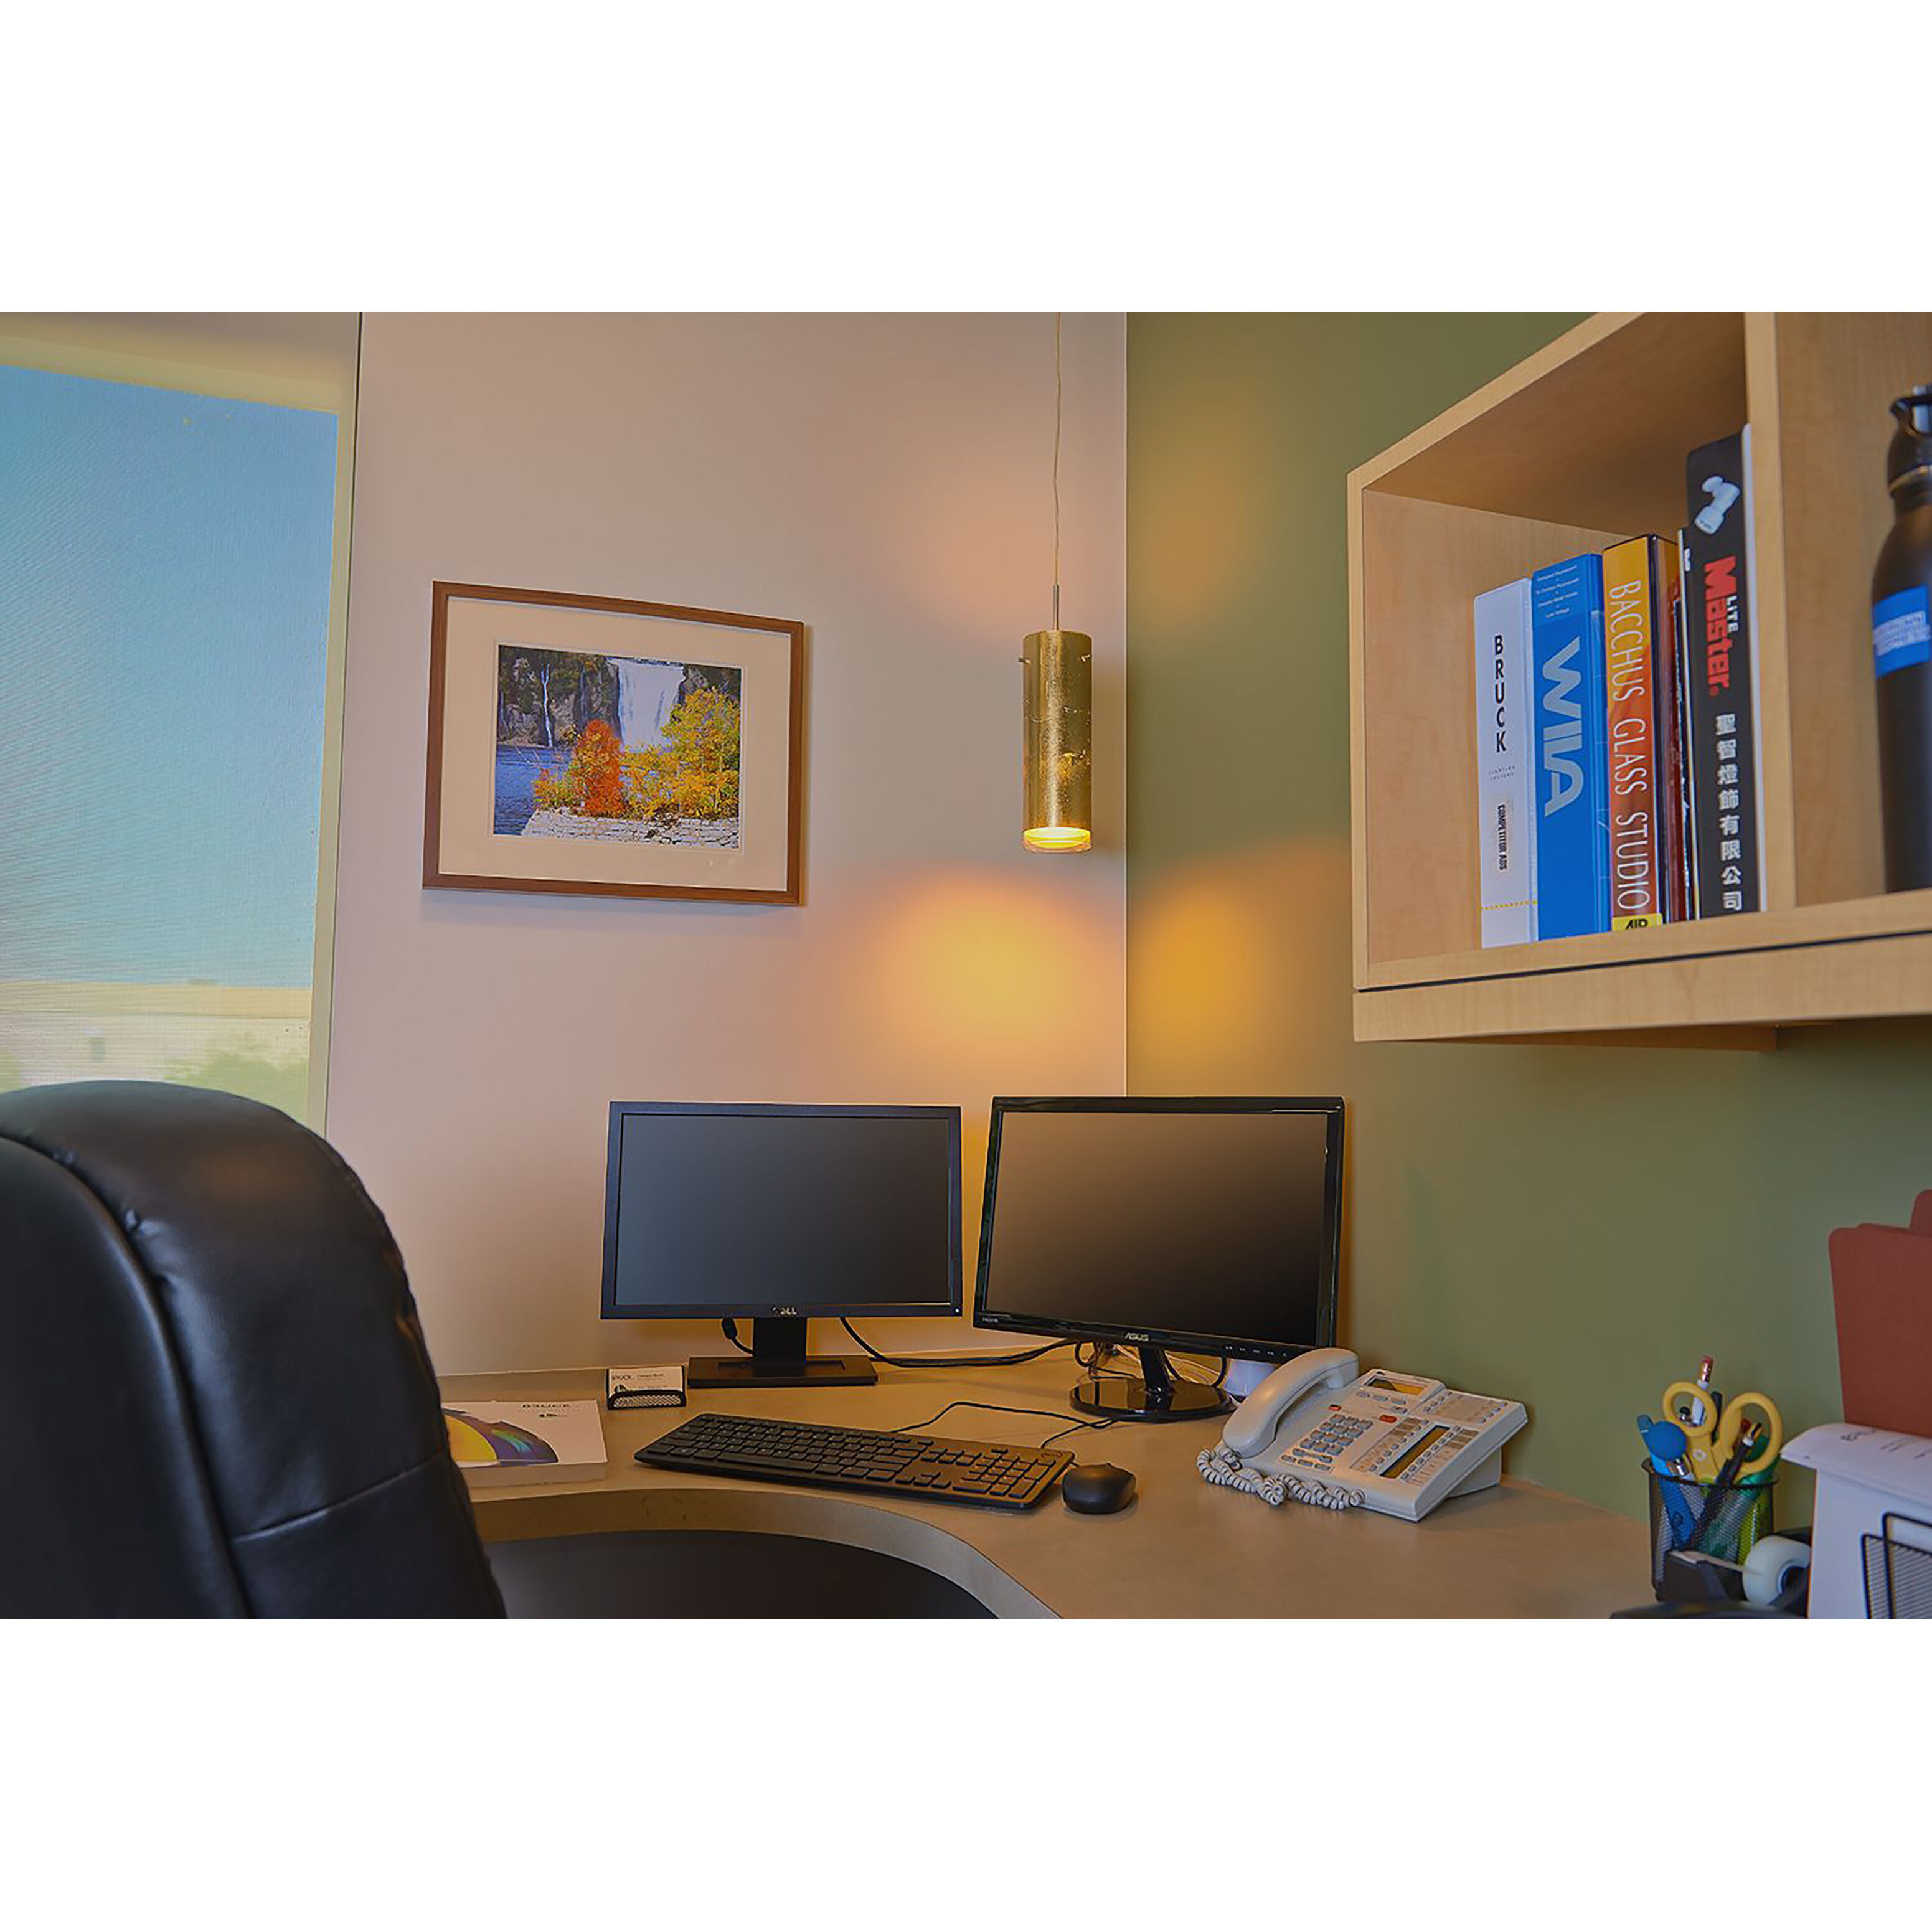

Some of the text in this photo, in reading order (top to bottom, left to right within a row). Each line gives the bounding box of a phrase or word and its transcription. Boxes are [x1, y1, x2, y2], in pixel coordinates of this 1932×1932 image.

[1726, 595, 1739, 634] LITE
[1494, 634, 1507, 753] BRUCK
[1610, 580, 1650, 910] BACCHUS GLASS STUDIO
[1124, 1332, 1149, 1342] ASUS
